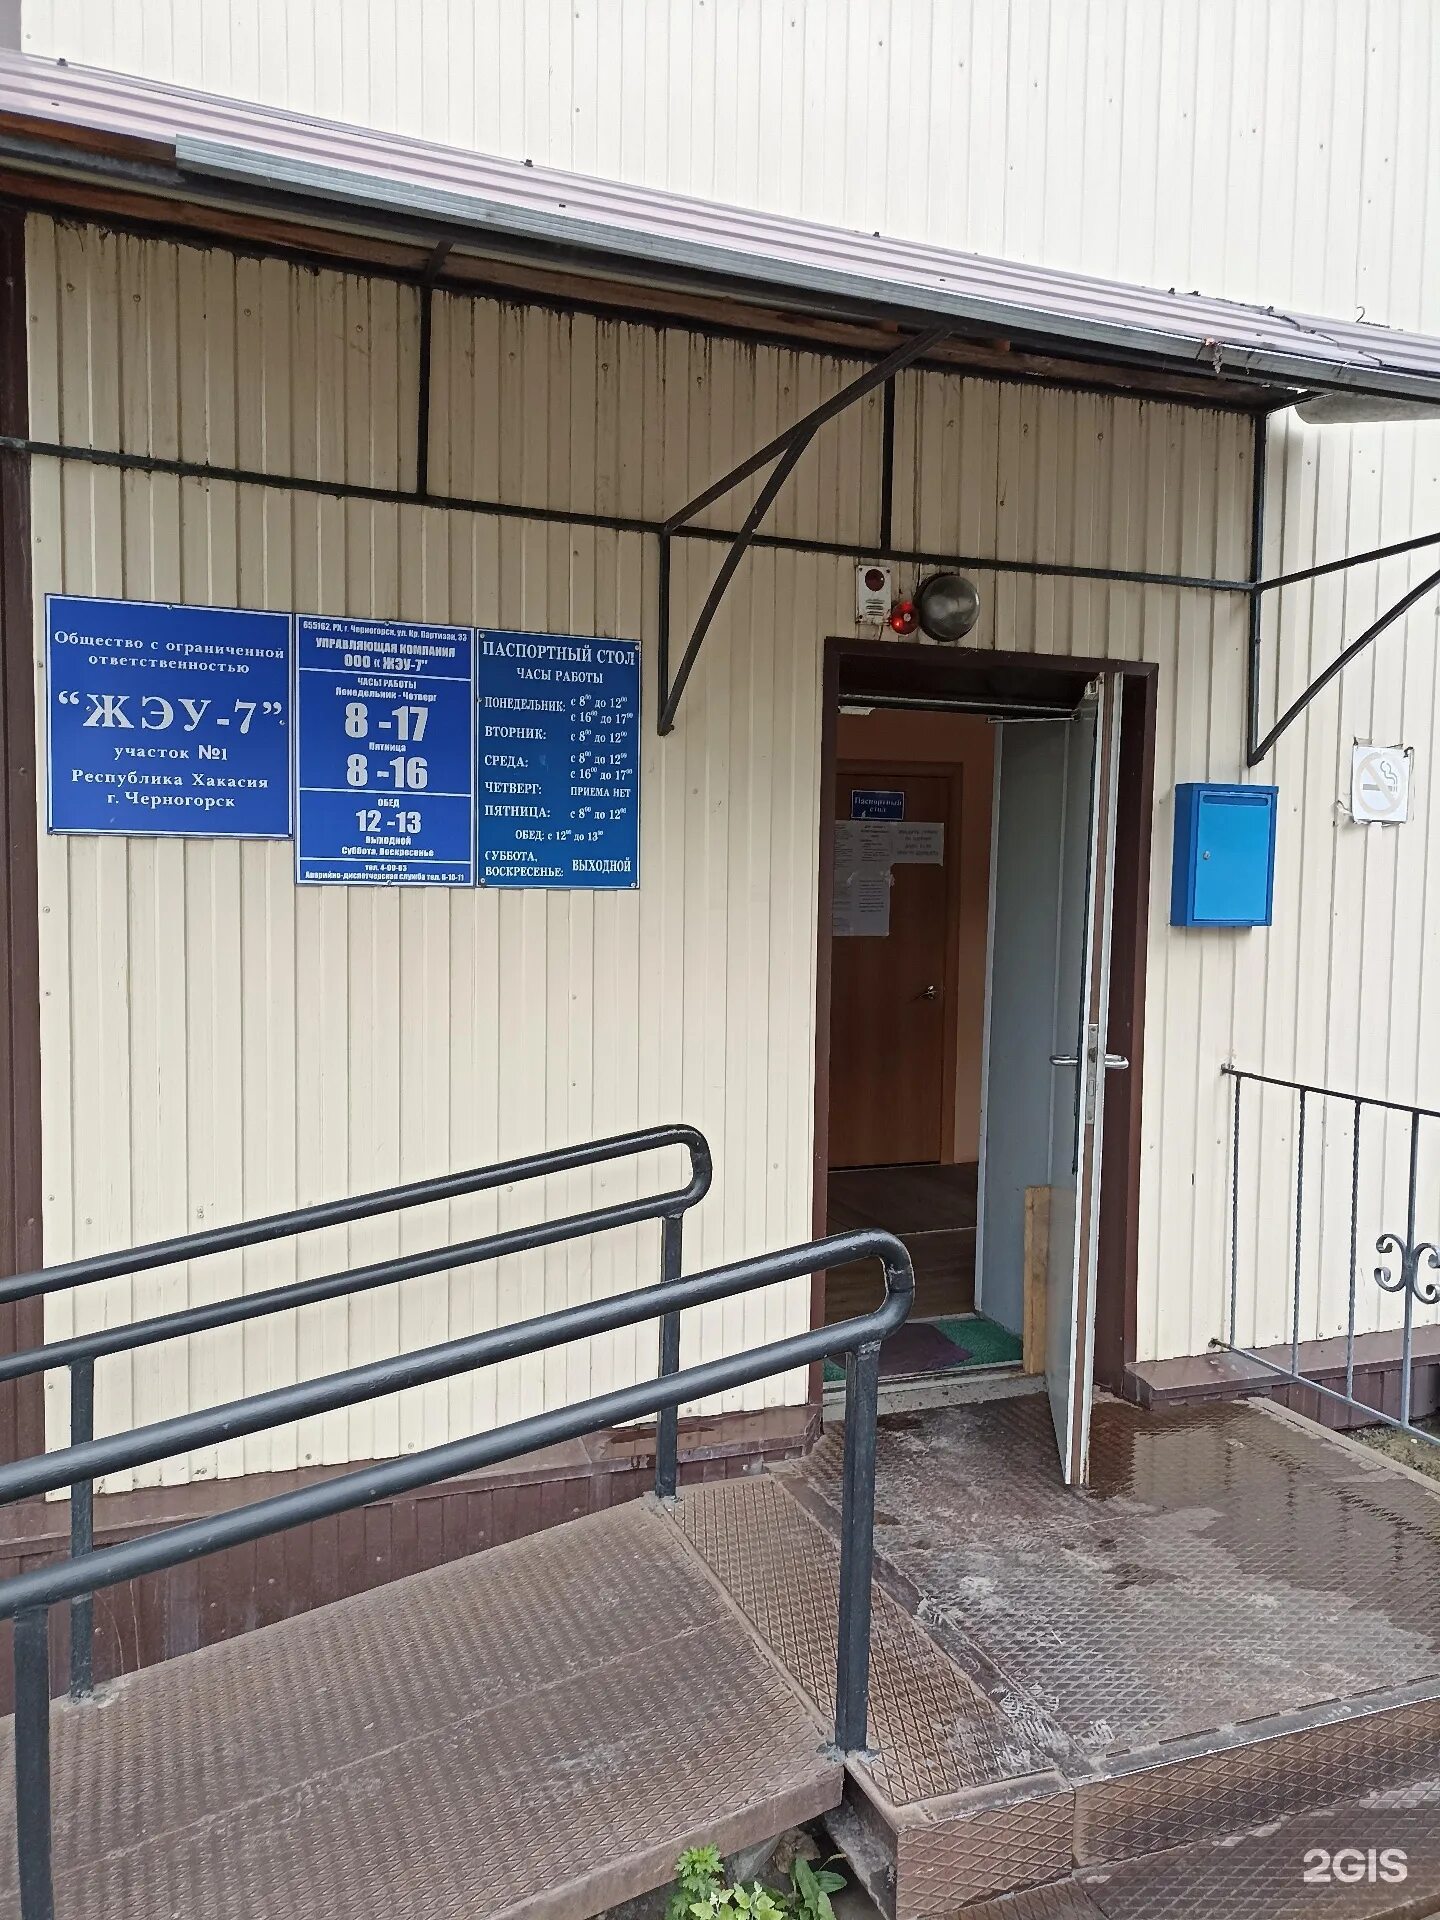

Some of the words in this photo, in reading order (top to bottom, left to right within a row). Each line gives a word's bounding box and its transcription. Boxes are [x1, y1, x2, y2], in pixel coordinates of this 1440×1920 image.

[397, 629, 408, 637] ул.
[408, 630, 420, 638] Кр.
[458, 634, 467, 642] 33
[54, 631, 143, 649] Общество
[151, 641, 158, 650] с
[166, 641, 284, 659] ограниченной
[316, 637, 397, 654] УПРАВЛЯЮЩАЯ
[399, 643, 456, 658] КОМПАНИЯ
[483, 641, 592, 663] ПАСПОРТНЫЙ
[596, 649, 635, 665] СТОЛ
[88, 654, 250, 674] ответственностью
[344, 654, 371, 668] ООО
[357, 677, 382, 687] ЧАСЫ
[383, 679, 417, 689] РАБОТЫ
[516, 668, 551, 681] ЧАСЫ
[555, 671, 603, 684] РАБОТЫ
[335, 686, 397, 699] Понедельник
[402, 691, 437, 702] Четверг
[484, 696, 566, 712] ПОНЕДЕЛЬНИК:
[595, 699, 606, 708] до
[600, 715, 612, 724] до
[484, 726, 546, 740] ВТОРНИК:
[571, 733, 576, 741] с
[594, 734, 606, 743] до
[114, 746, 190, 761] участок
[198, 745, 227, 760] №1
[369, 742, 406, 752] Пятница
[484, 755, 529, 768] СРЕДА:
[570, 754, 576, 762] с
[594, 756, 606, 764] до
[71, 769, 183, 787] Республика
[191, 773, 269, 788] Хакасия
[570, 770, 576, 778] с
[600, 772, 611, 780] до
[485, 781, 542, 795] ЧЕТВЕРГ:
[570, 787, 610, 797] ПРИЕМА
[612, 789, 631, 798] НЕТ
[106, 793, 119, 804] г.
[124, 791, 235, 810] Черногорск
[377, 798, 400, 808] ОБЕД
[484, 805, 550, 818] ПЯТНИЦА:
[570, 810, 576, 819] с
[594, 810, 606, 819] до
[515, 830, 544, 841] ОБЕД:
[547, 832, 553, 840] с
[574, 833, 584, 841] до
[379, 848, 435, 857] Воскресенье
[484, 851, 538, 862] СУББОТА,
[572, 857, 631, 874] ВЫХОДНОЙ
[305, 870, 399, 880] Аварийно-диспетчерская
[399, 872, 426, 881] служба
[485, 867, 564, 877] ВОСКРЕСЕНЬЕ:
